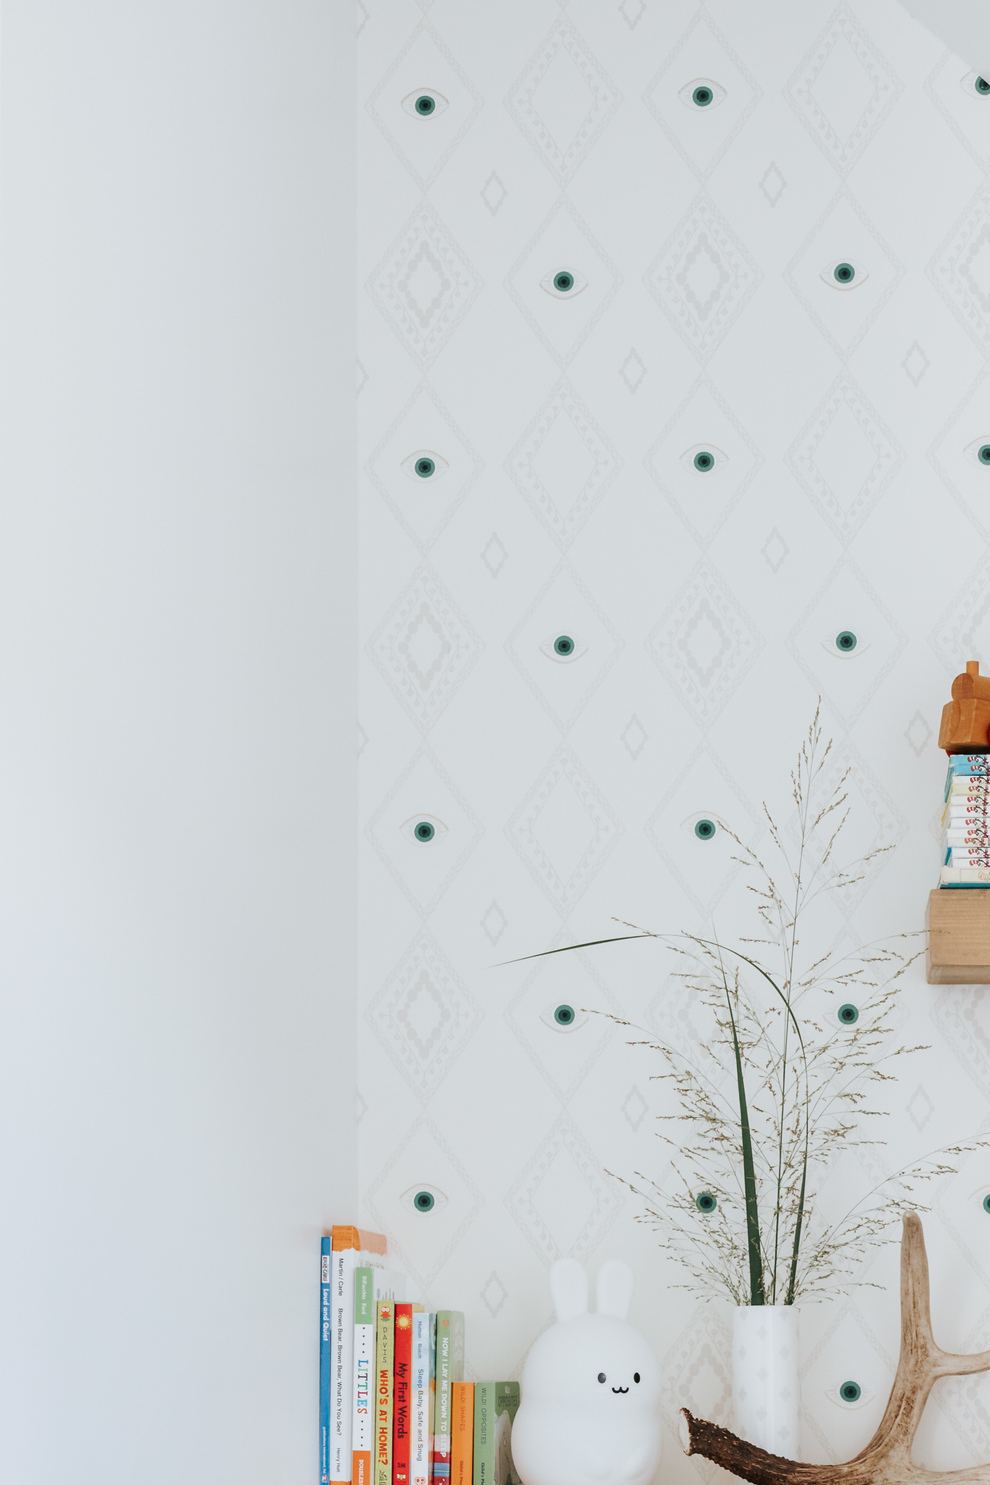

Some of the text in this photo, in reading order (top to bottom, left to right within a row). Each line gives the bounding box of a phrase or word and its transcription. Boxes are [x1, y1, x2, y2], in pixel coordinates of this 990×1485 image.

[357, 1360, 368, 1414] LITTLES
[380, 1370, 389, 1405] WHO'S
[442, 1380, 448, 1392] ME
[337, 1398, 342, 1407] Do
[397, 1362, 408, 1439] My First Words
[379, 1410, 387, 1422] AT
[441, 1422, 447, 1431] TO
[379, 1427, 388, 1466] HOME?
